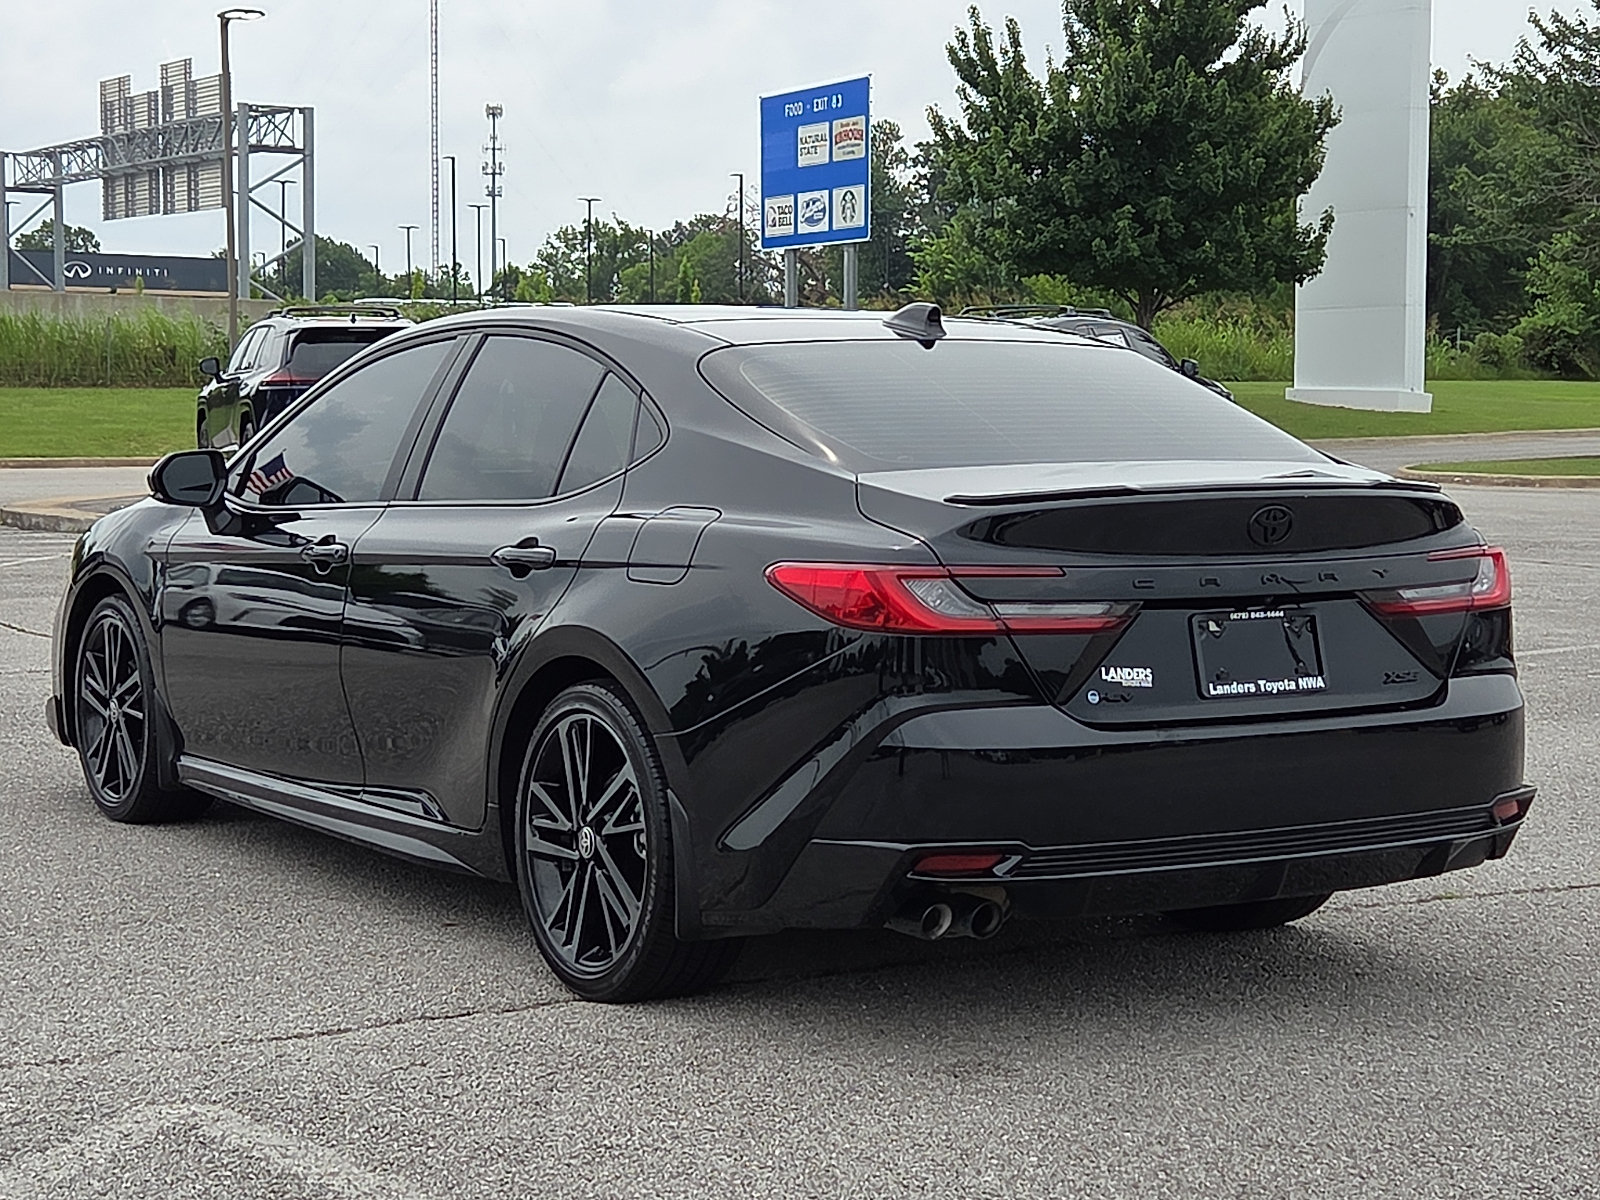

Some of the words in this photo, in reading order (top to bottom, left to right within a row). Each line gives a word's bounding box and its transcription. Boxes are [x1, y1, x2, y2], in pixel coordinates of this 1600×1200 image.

[784, 101, 804, 117] FOOD
[813, 97, 829, 112] EXIT
[800, 132, 828, 146] NATURAL
[800, 145, 818, 157] STATE
[777, 204, 793, 216] TACO
[778, 216, 793, 228] BELL
[98, 266, 169, 278] INFINITI
[1101, 666, 1153, 682] LANDERS
[1209, 681, 1256, 695] Landers
[1257, 679, 1297, 694] Toyota
[1298, 676, 1326, 690] NWA
